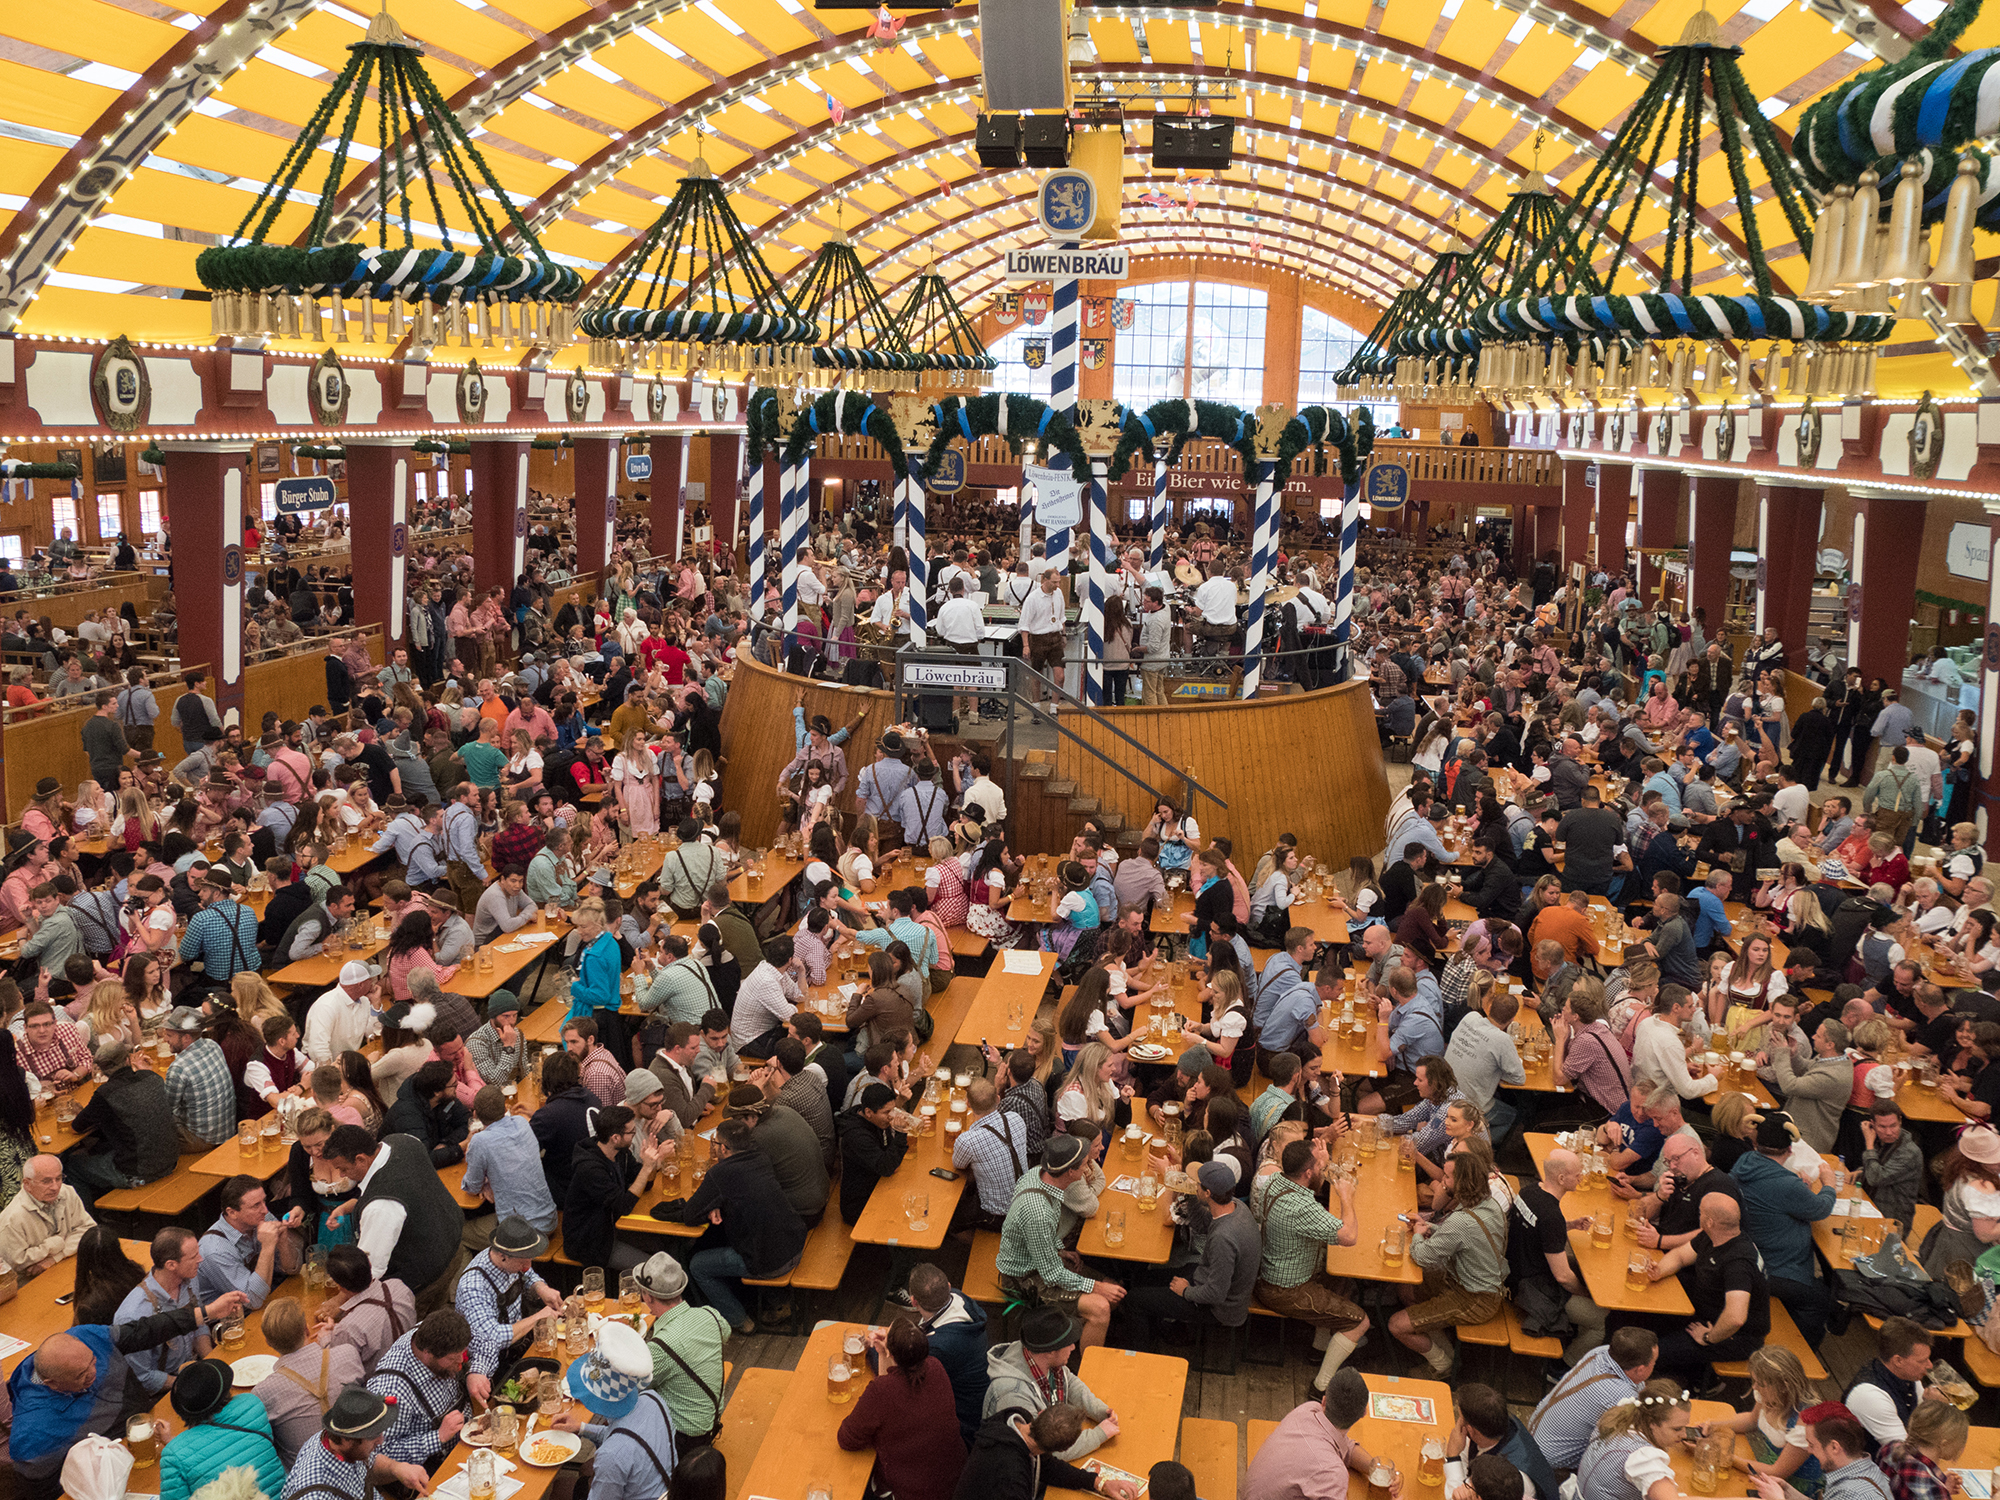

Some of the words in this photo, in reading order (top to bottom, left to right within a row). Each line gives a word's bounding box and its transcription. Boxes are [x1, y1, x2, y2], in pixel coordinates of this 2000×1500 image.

[1007, 252, 1123, 274] LÖWENBRÄU
[1028, 469, 1072, 481] Löwenbräu-FESTK
[1169, 473, 1205, 489] Bier
[1210, 475, 1241, 490] wie
[281, 489, 308, 509] Bürger
[308, 486, 329, 502] Stubn
[1964, 540, 1989, 566] Span
[905, 668, 994, 684] Löwenbräu
